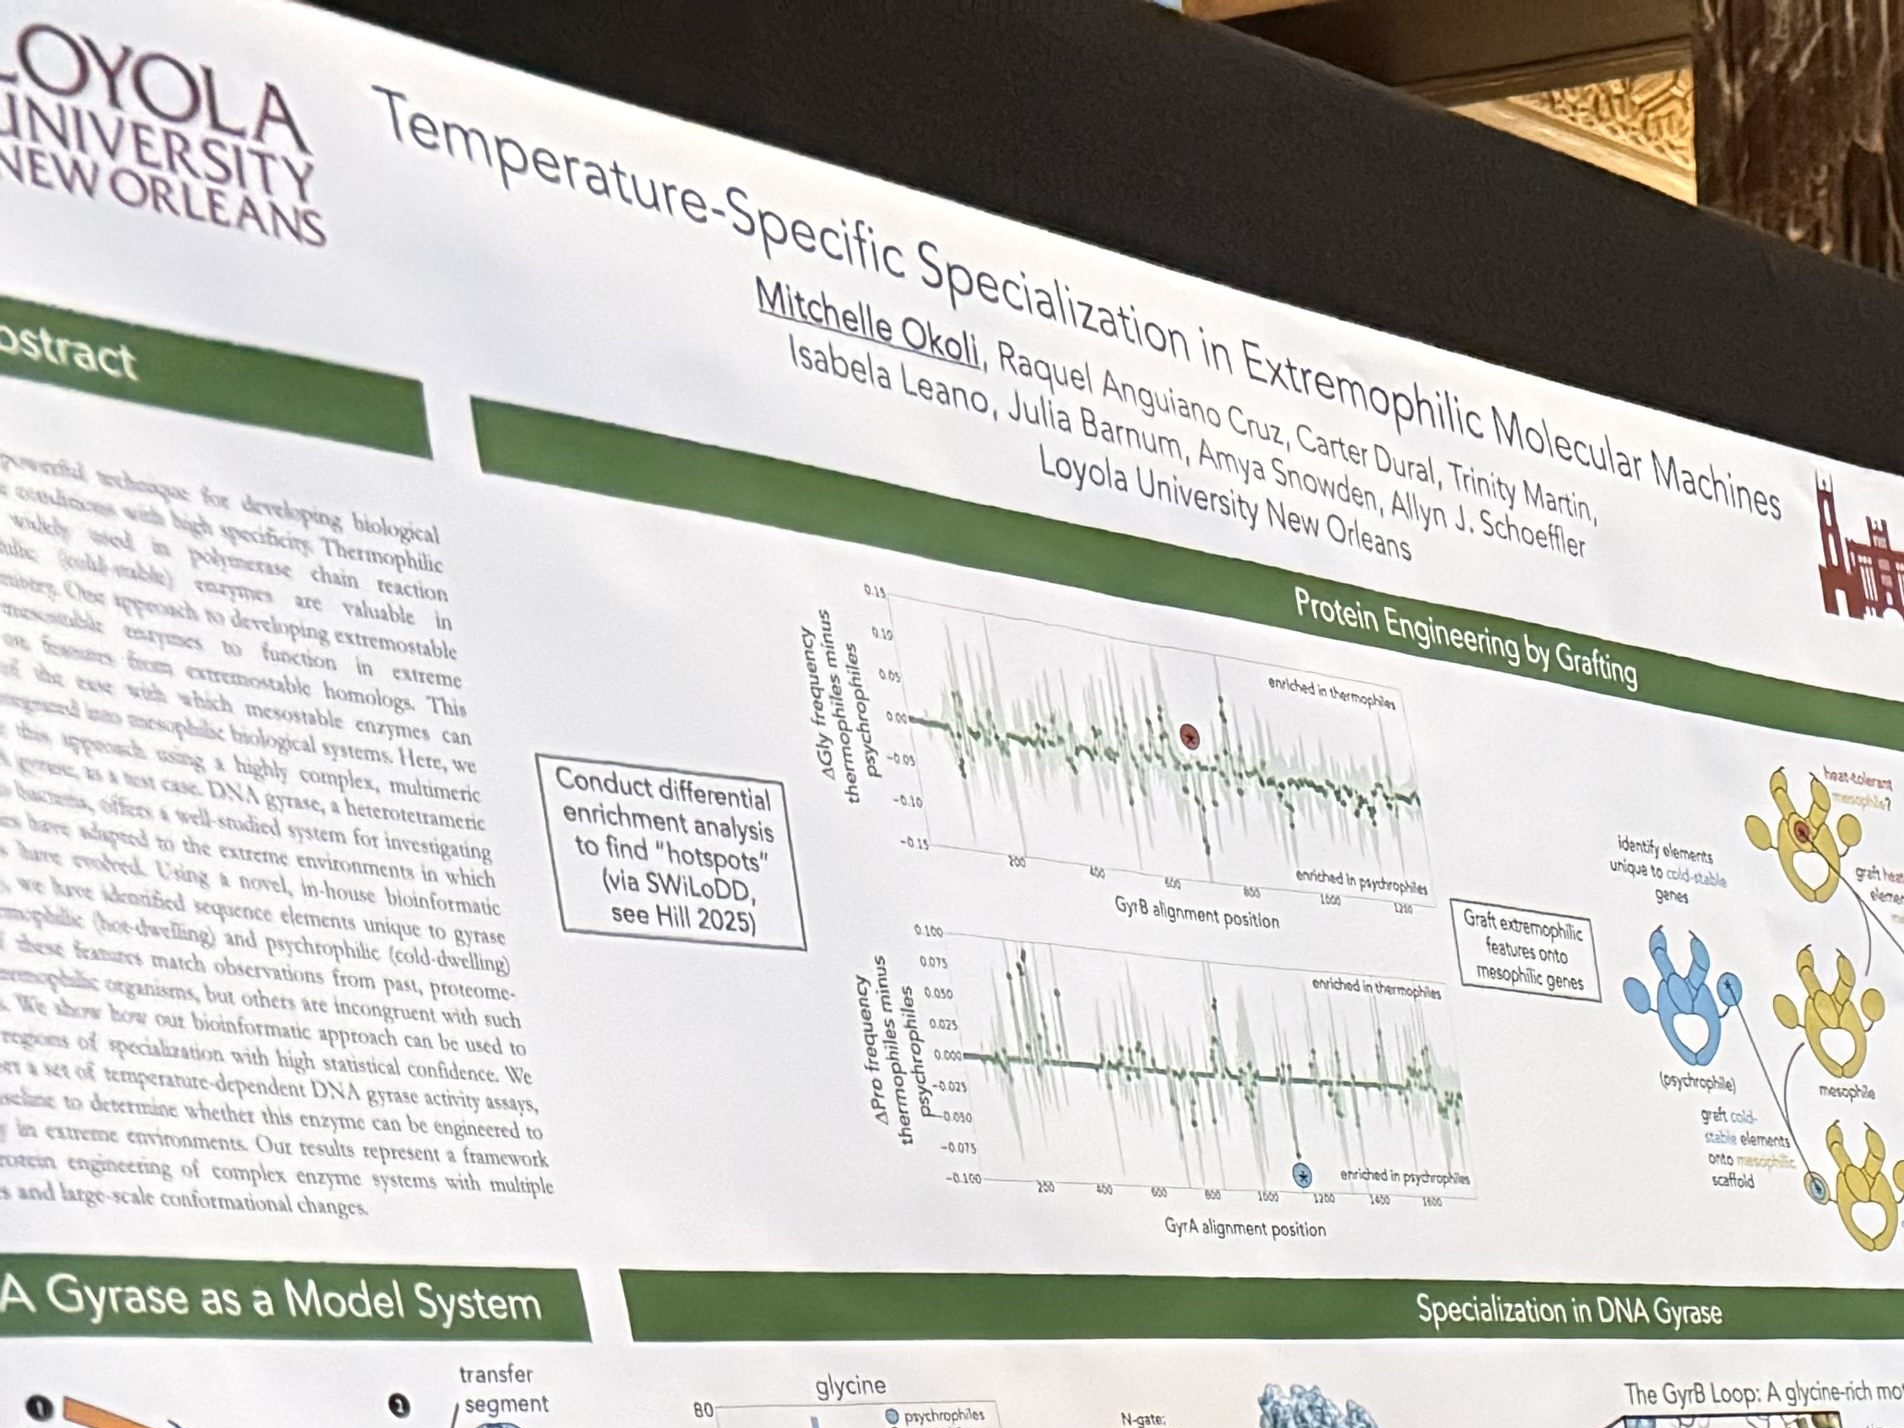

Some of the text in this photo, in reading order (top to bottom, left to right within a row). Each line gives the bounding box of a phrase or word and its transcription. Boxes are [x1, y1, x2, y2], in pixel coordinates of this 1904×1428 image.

[0, 23, 313, 156] OYOLA
[108, 167, 327, 248] ORLEANS
[371, 84, 1782, 521] Temperature-Specific Specialization in Extremophilic Molecular Machines
[755, 275, 1598, 528] Mitchelle Okoli, Raquel Anguiano Cruz, Carter Dural, Trinity Martin,
[788, 333, 1586, 558] Isabela Leano, Julia Barnum, Amya Snowden, Allyn J. Schoeffler
[1039, 443, 1412, 562] Loyola University New Orleans
[1294, 586, 1638, 693] Protein Engineering by Grafting
[555, 765, 771, 812] Conduct differential
[562, 802, 775, 846] enrichment analysis
[574, 835, 600, 856] to
[605, 833, 649, 861] find
[602, 866, 640, 895] (via
[611, 903, 756, 937] see Hill 2025)
[1463, 907, 1584, 943] Graft extremophilic
[1485, 935, 1569, 965] features onto
[1476, 965, 1585, 992] mesophilic genes
[1164, 1216, 1327, 1241] GyrA alignment position
[46, 1272, 189, 1324] Gyrase
[201, 1288, 242, 1317] as
[251, 1289, 275, 1318] a
[283, 1277, 405, 1319] Model
[413, 1281, 542, 1329] System
[1416, 1292, 1723, 1332] Specialization in DNA Gyrase
[459, 1362, 533, 1384] transfer
[815, 1373, 887, 1401] glycine
[465, 1395, 550, 1419] segment
